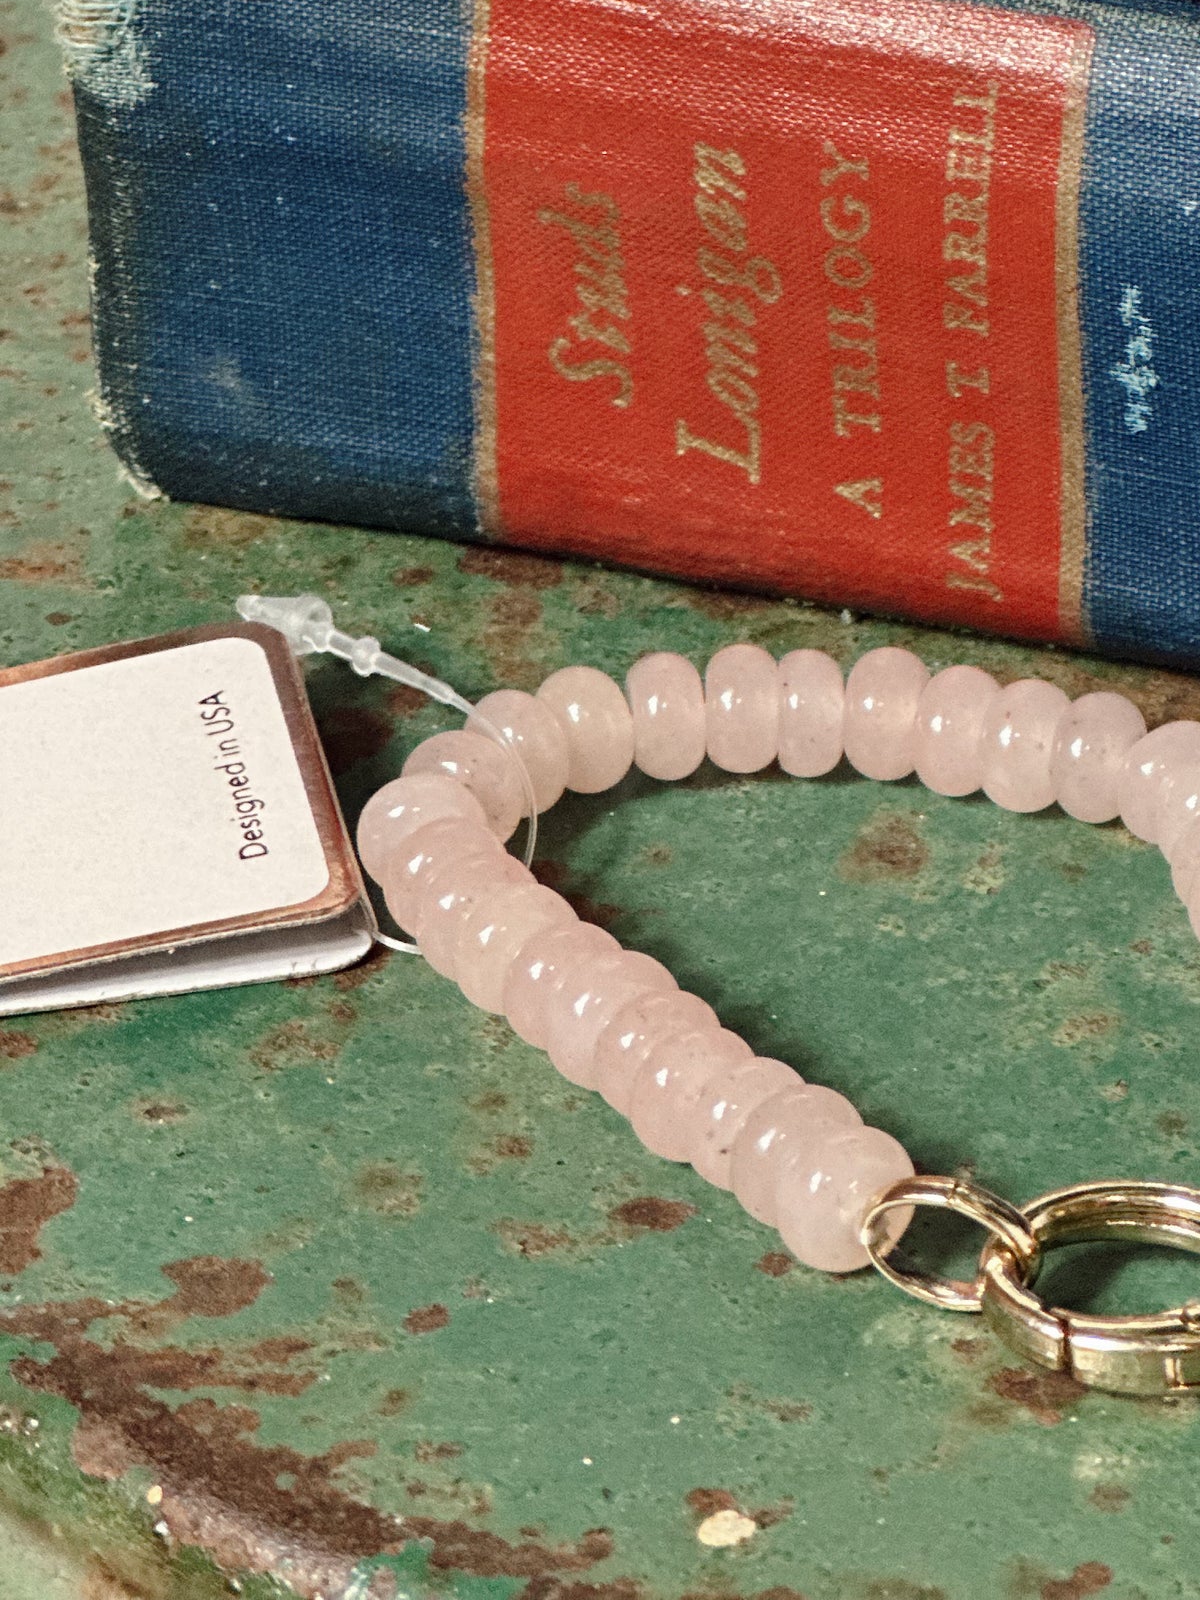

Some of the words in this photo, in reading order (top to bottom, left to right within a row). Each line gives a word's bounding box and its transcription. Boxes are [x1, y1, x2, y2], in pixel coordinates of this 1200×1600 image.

[537, 182, 633, 407] Studs
[820, 142, 882, 438] TRILOGY
[943, 79, 998, 337] FARRELL
[674, 141, 783, 485] Lonigan
[834, 475, 884, 518] A
[945, 420, 1003, 602] JAMES
[198, 690, 234, 736] USA
[213, 737, 242, 760] in
[213, 761, 269, 860] Designed
